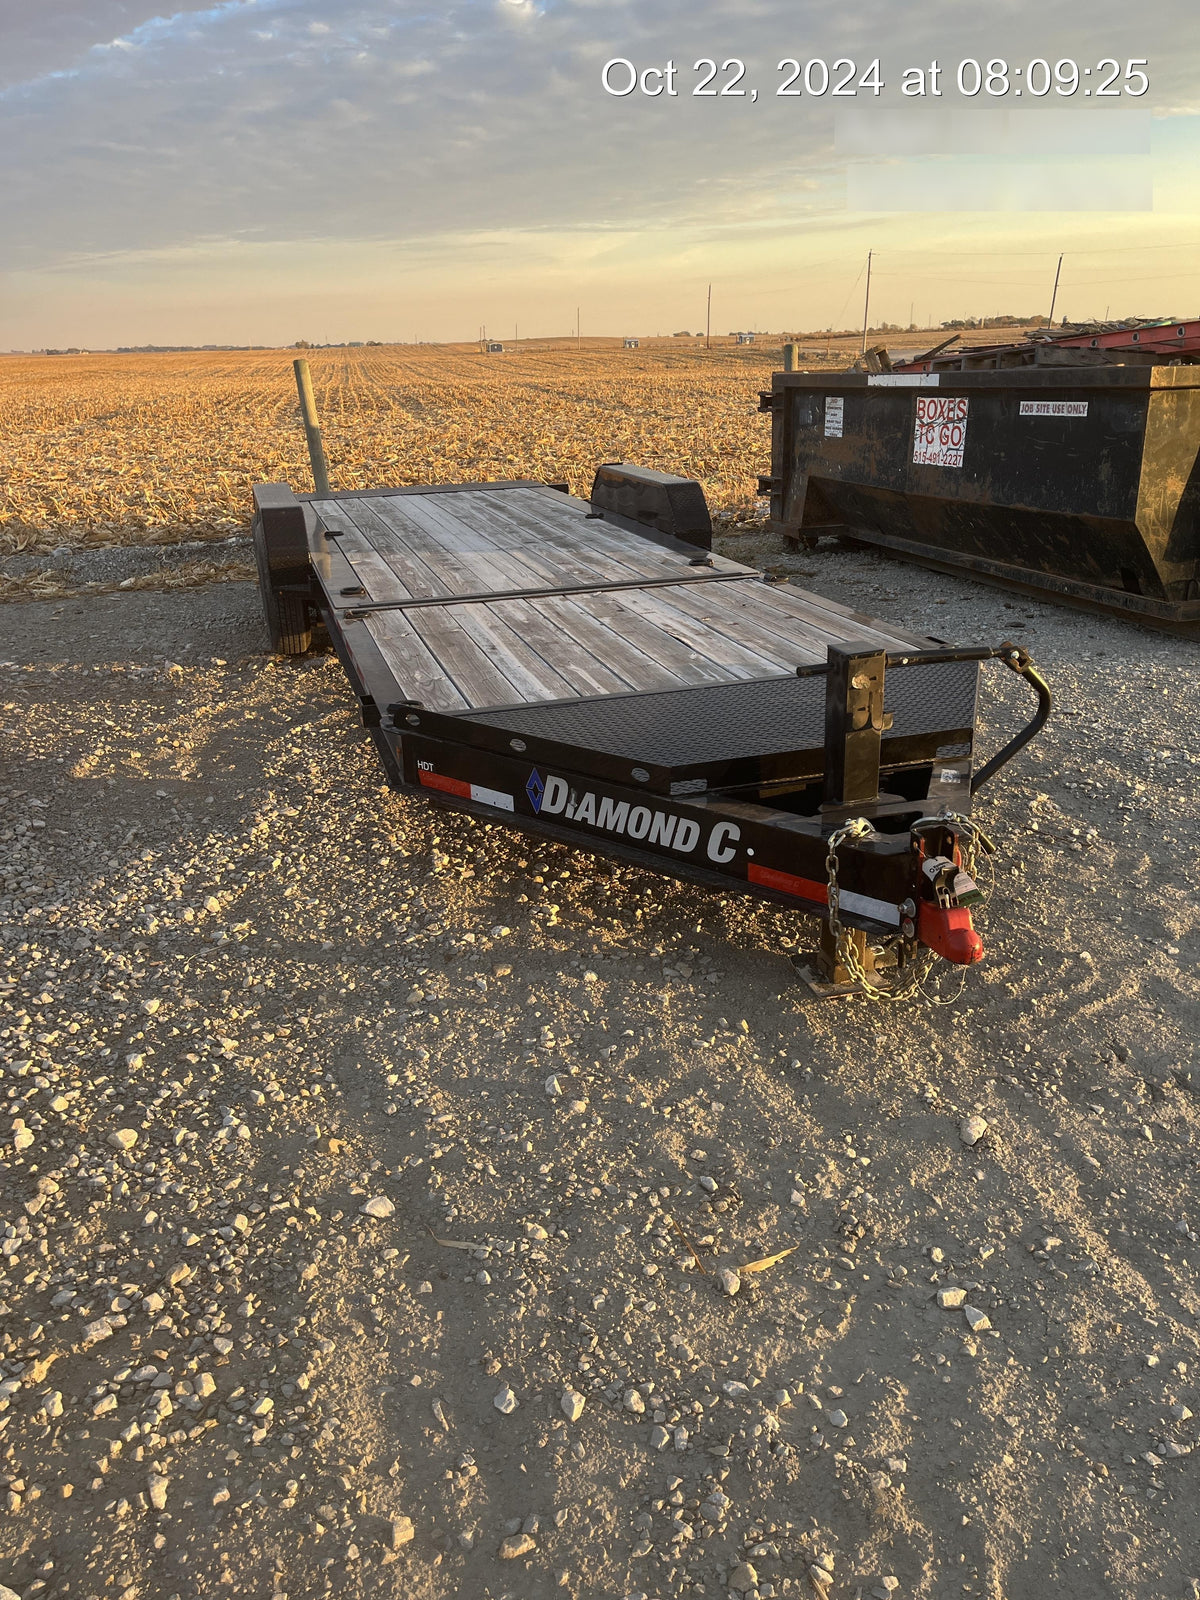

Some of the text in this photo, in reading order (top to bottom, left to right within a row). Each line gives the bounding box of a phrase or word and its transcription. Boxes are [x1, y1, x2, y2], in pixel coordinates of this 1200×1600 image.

[917, 399, 967, 421] BOXES
[1021, 404, 1087, 415] JOB SITE USE ONLY
[939, 424, 962, 447] GO
[913, 451, 963, 466] 515-491-2227
[417, 760, 434, 772] HDT
[540, 774, 741, 864] DIAMOND C
